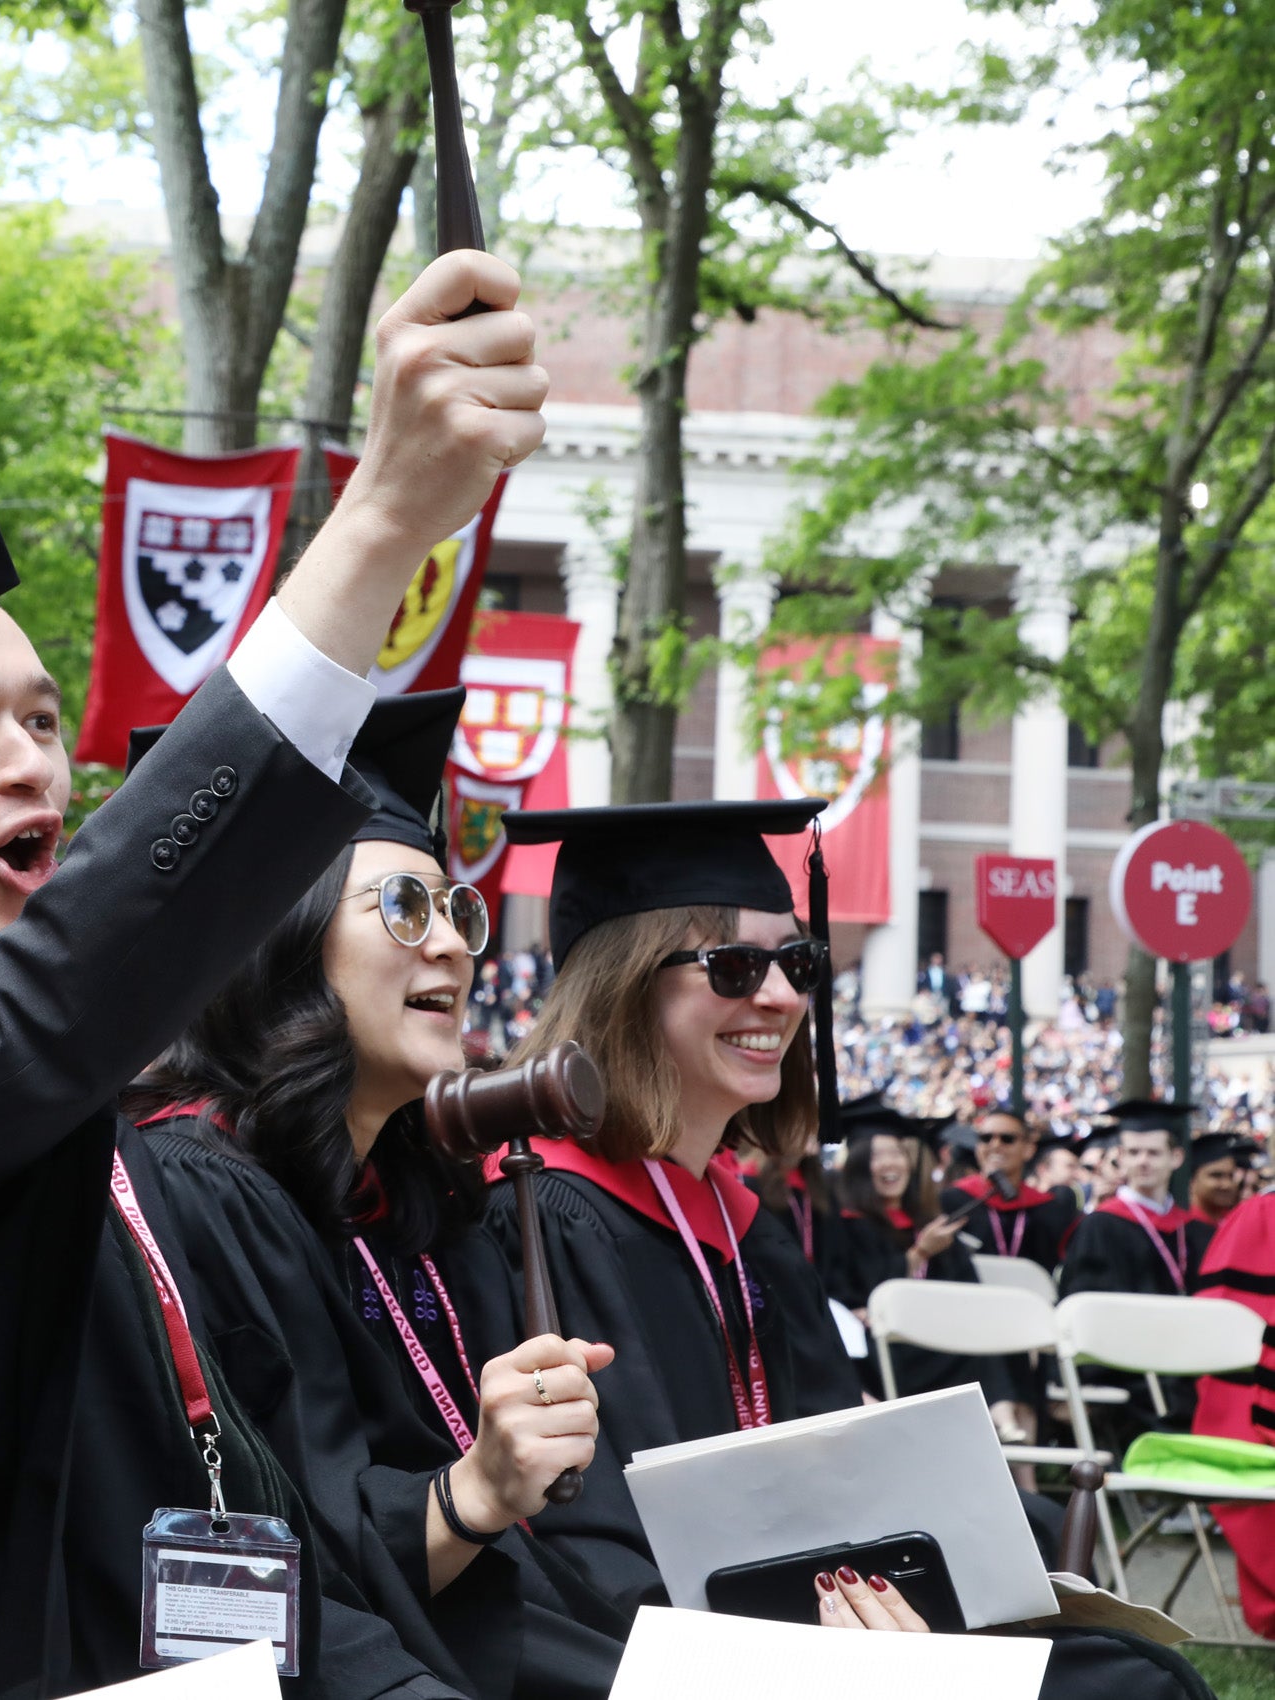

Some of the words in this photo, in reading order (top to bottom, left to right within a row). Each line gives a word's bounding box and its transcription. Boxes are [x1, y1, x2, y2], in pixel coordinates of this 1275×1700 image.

[988, 867, 1054, 898] SEAS
[1150, 861, 1223, 894] Point
[1176, 894, 1199, 926] E
[210, 1588, 249, 1598] TRANSFERABLE
